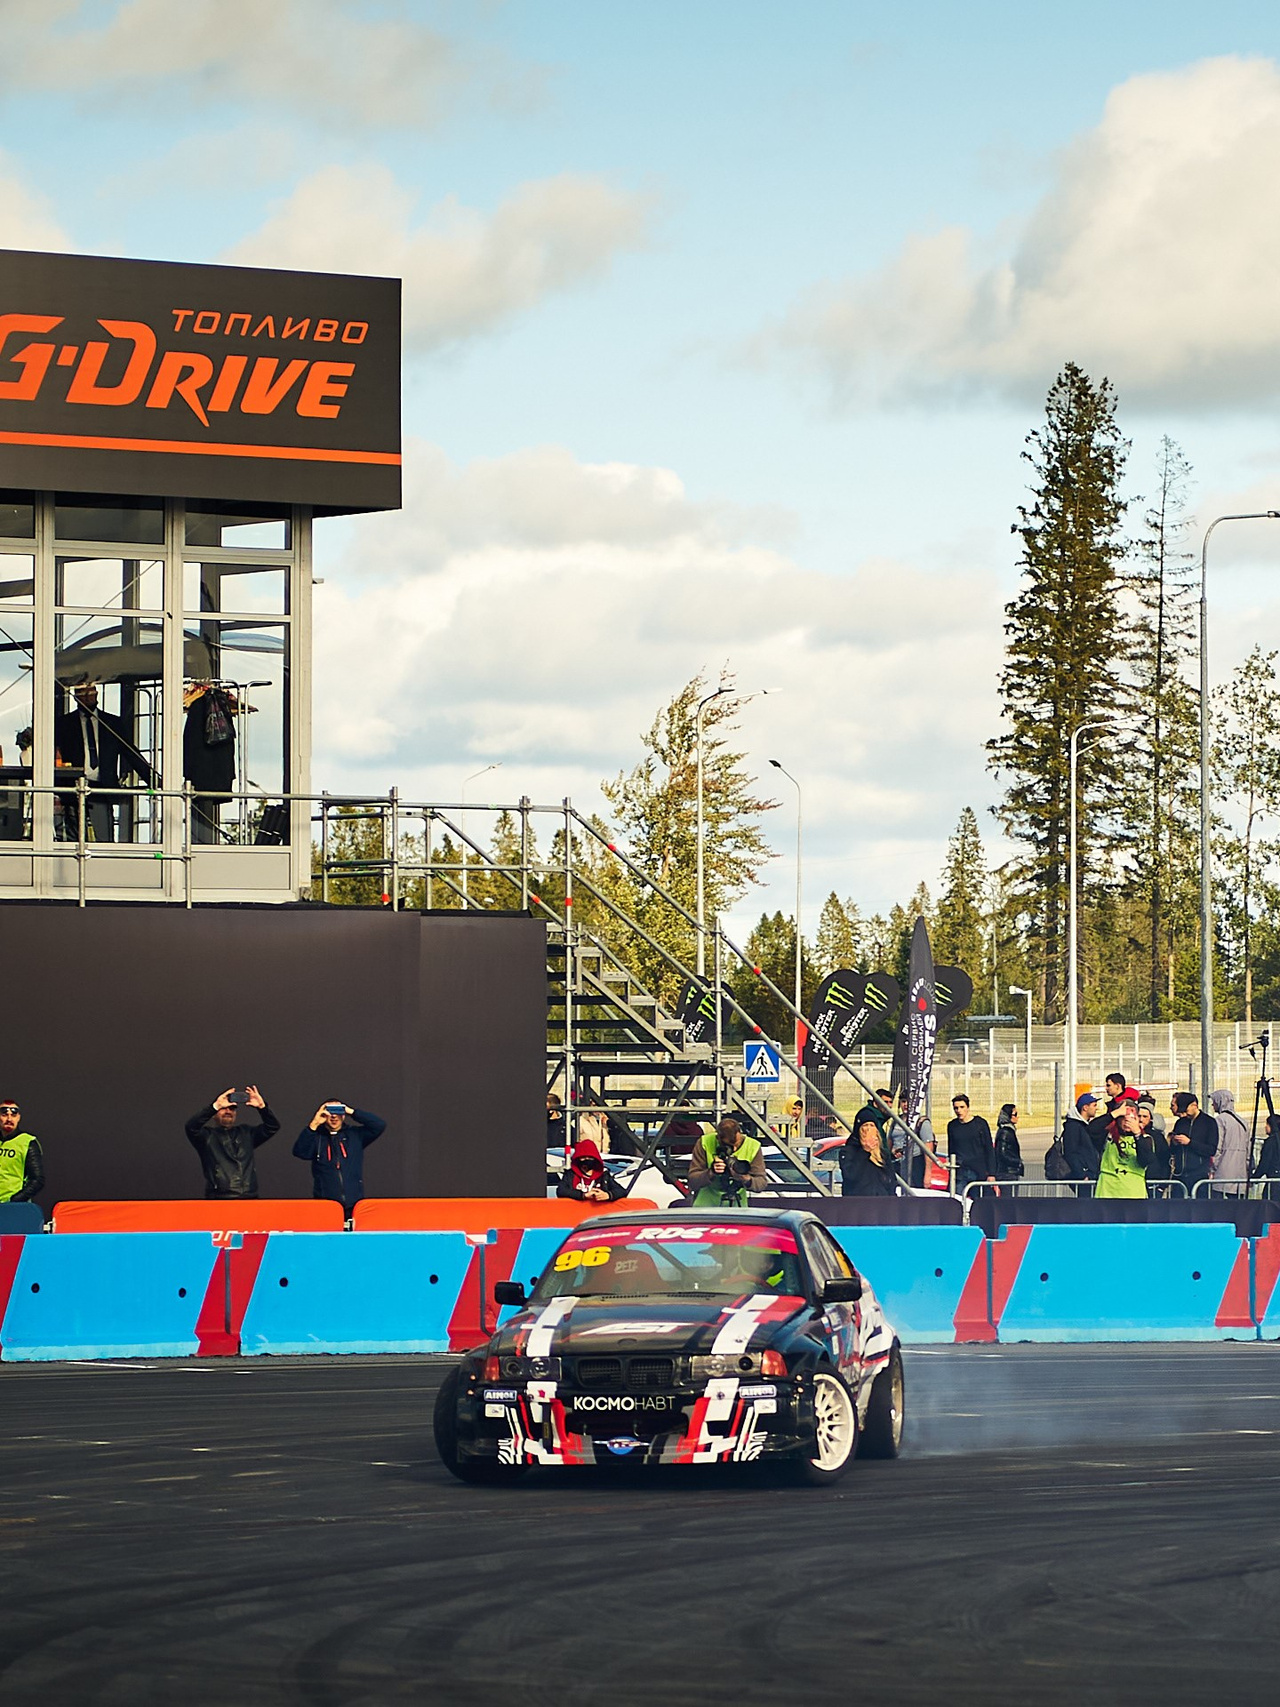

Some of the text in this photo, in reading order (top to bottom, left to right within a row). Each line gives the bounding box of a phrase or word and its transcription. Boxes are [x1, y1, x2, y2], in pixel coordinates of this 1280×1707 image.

[172, 309, 369, 345] ТОПЛИВО
[635, 1227, 710, 1240] RDS
[554, 1246, 612, 1272] 96
[573, 1396, 676, 1411] КОСМОНАВТ
